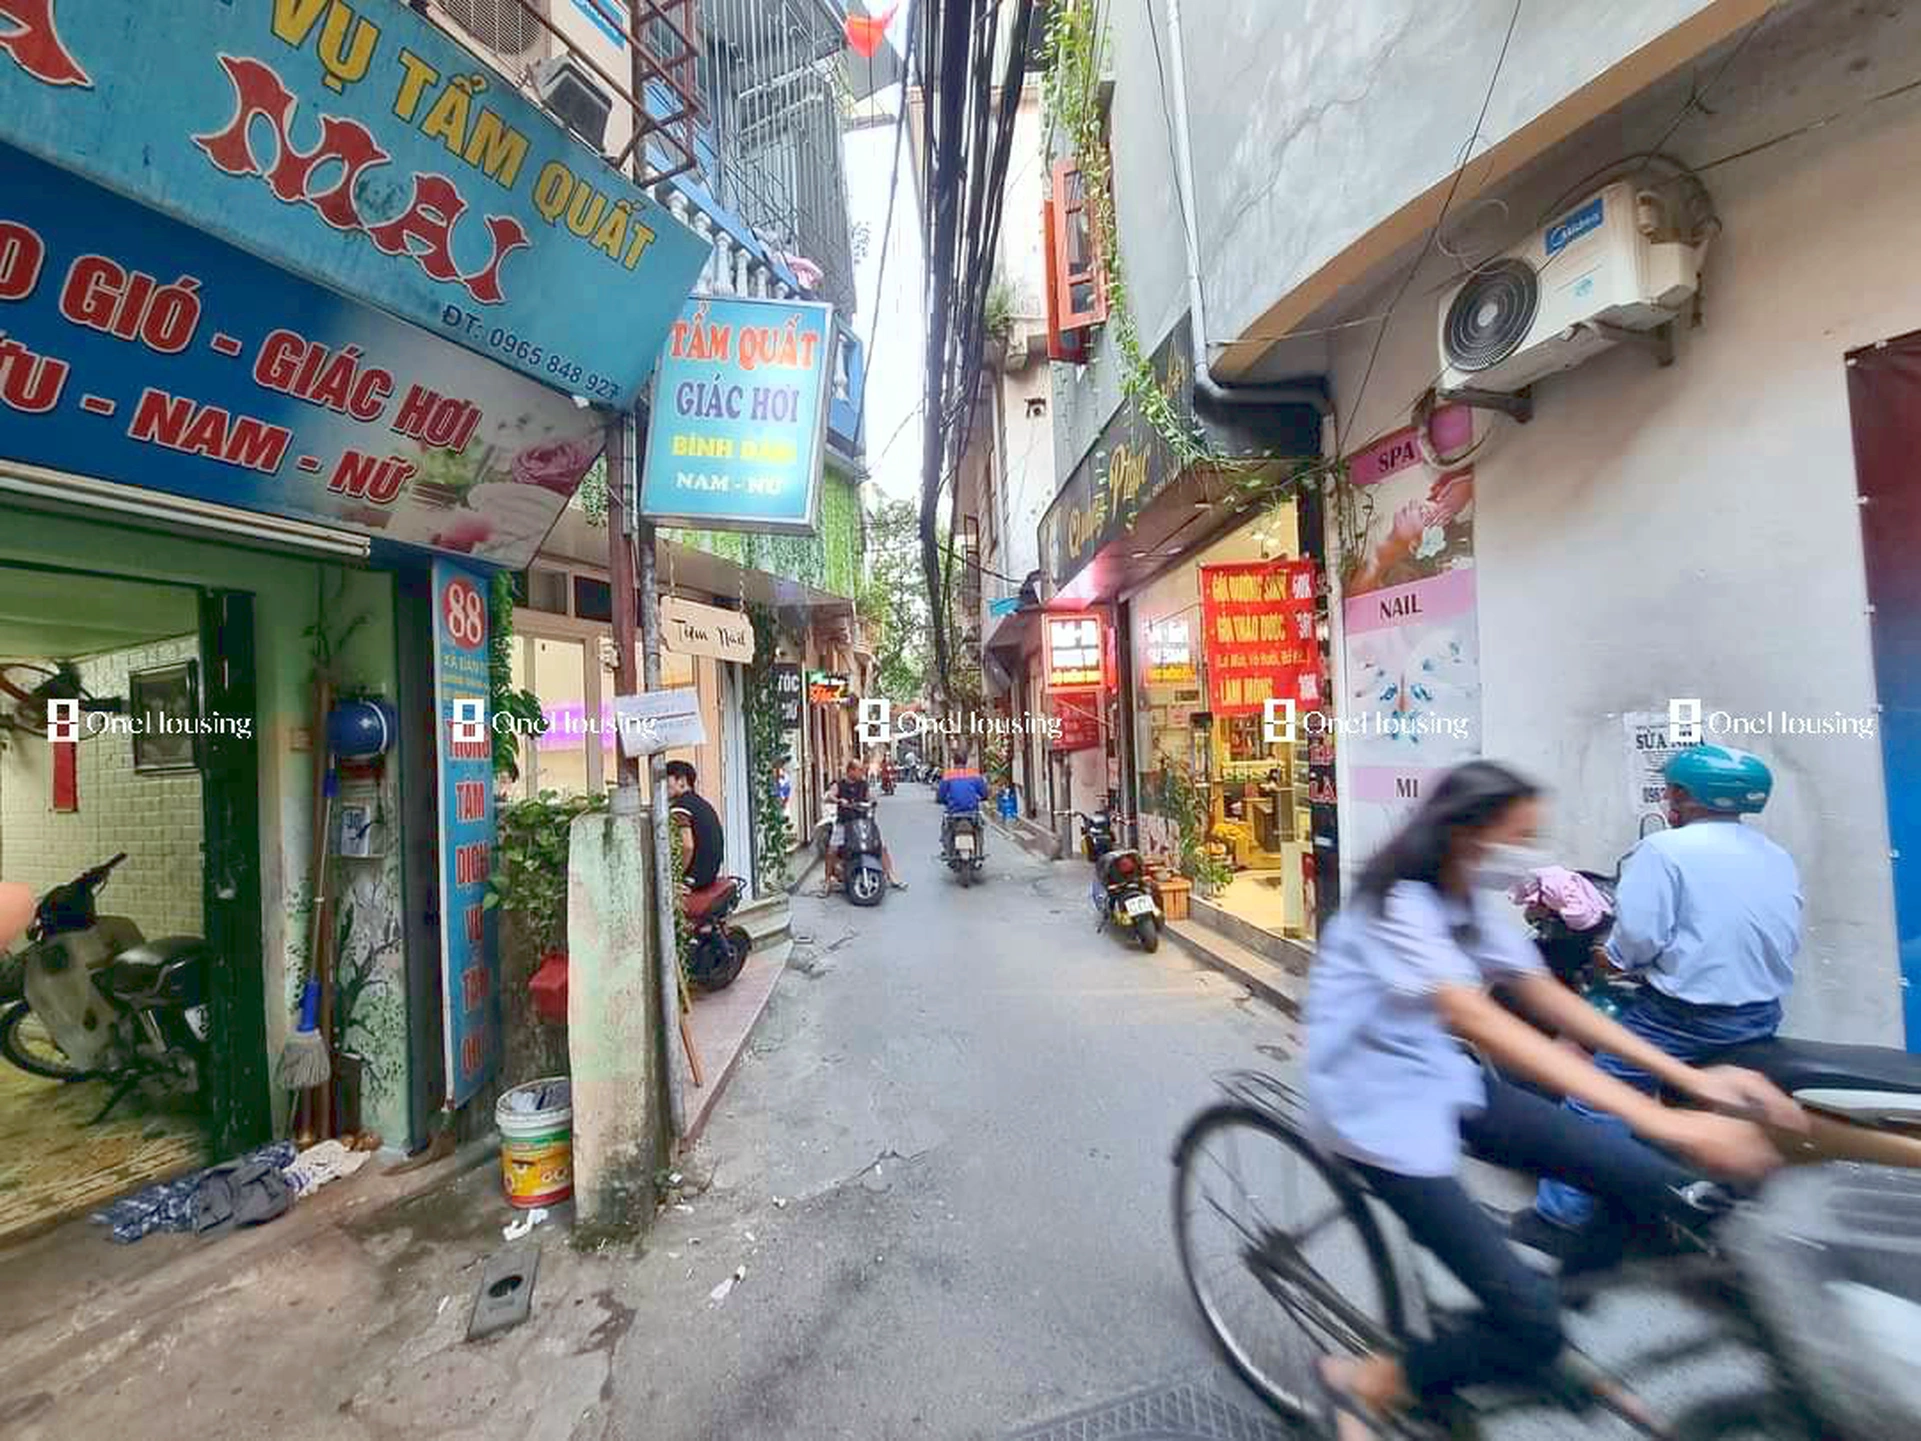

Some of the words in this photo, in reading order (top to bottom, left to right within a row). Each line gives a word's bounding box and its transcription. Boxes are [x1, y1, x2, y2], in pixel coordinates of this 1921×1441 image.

[270, 0, 380, 95] VỤ
[391, 48, 533, 190] TẨM
[531, 158, 657, 273] QUẤT
[59, 253, 202, 353] GIÓ
[253, 328, 396, 421] GIÁC
[388, 382, 484, 455] HƠI
[489, 328, 543, 366] 0965
[546, 354, 583, 384] 848
[671, 300, 731, 362] TẨM
[738, 314, 820, 371] QUẤT
[676, 371, 744, 420] GIÁC
[129, 387, 293, 474] NAM
[326, 448, 417, 504] NỮ
[1378, 440, 1415, 473] SPA
[676, 471, 729, 493] NAM
[450, 583, 482, 643] 88
[1379, 593, 1423, 620] NAIL
